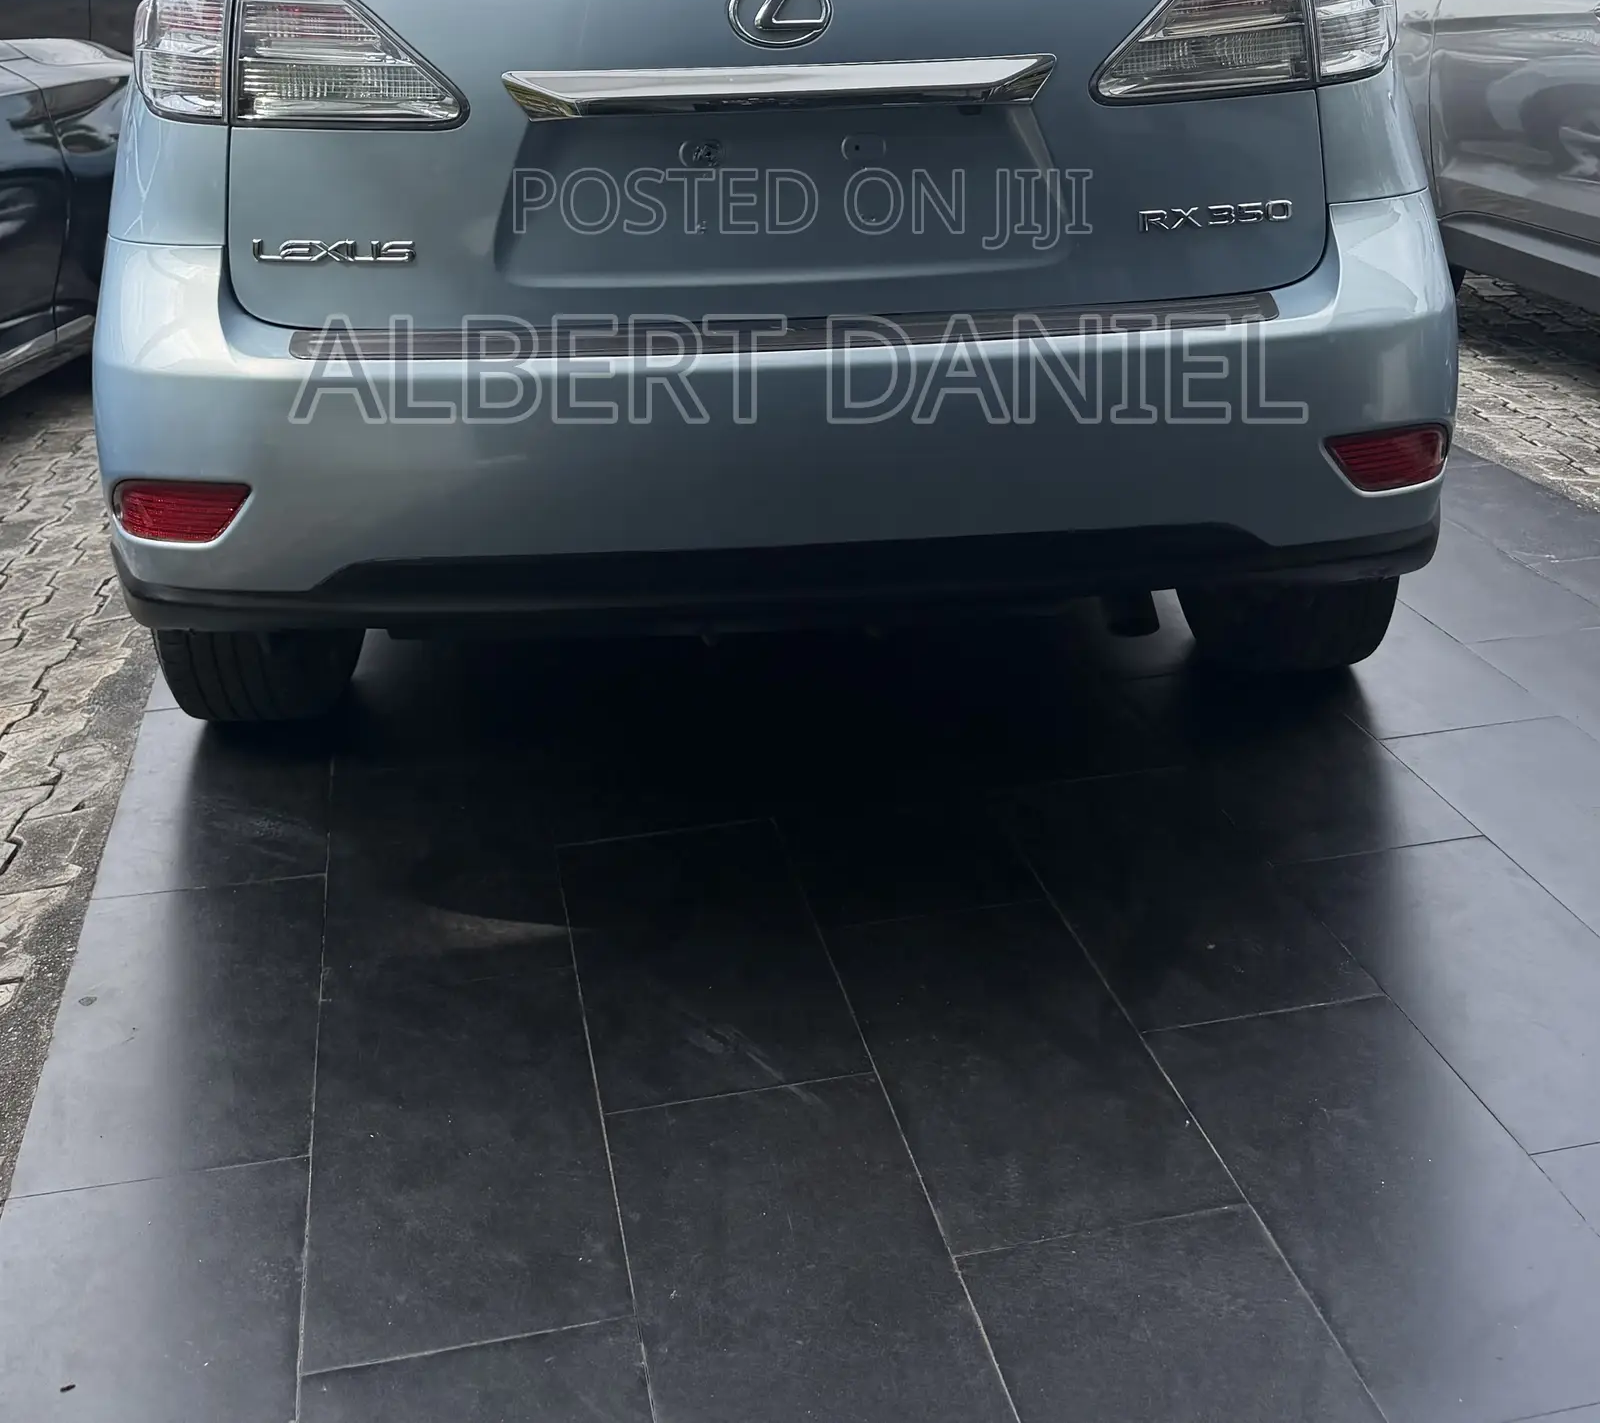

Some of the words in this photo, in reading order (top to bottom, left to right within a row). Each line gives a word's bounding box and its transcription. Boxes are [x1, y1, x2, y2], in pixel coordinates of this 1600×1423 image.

[1138, 205, 1203, 233] RX
[1207, 199, 1294, 228] 350
[252, 237, 417, 264] LEXUS
